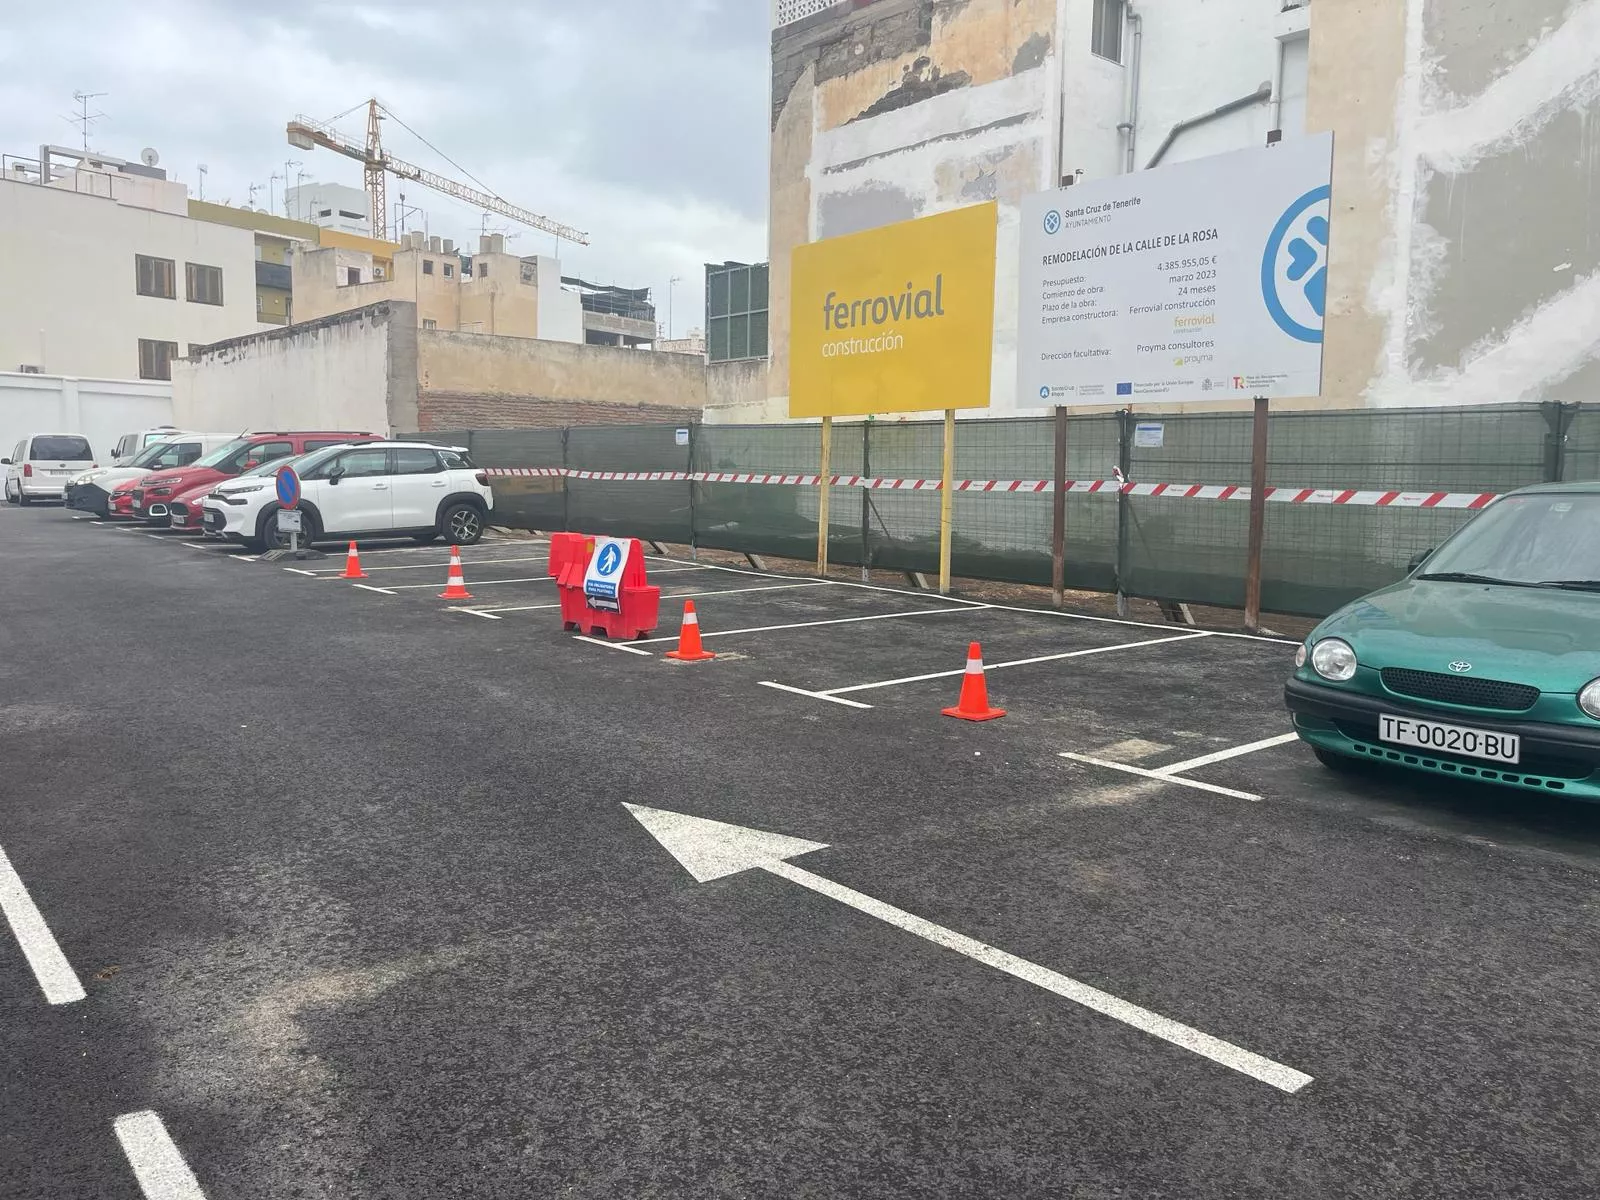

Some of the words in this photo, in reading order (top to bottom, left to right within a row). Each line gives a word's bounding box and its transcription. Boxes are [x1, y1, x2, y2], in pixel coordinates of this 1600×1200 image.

[1065, 209, 1085, 219] Santa
[1085, 205, 1101, 215] Cruz
[1102, 203, 1111, 212] de
[1112, 197, 1141, 210] Tenerife
[1065, 214, 1112, 229] AYUNTAMIENTO
[1042, 245, 1107, 266] REMODELACIÓN
[1109, 244, 1121, 256] DE
[1123, 242, 1134, 253] LA
[1135, 236, 1162, 251] CALLE
[1164, 234, 1176, 247] DE
[1178, 232, 1190, 245] LA
[1192, 228, 1218, 243] ROSA
[1157, 256, 1210, 271] 4.385.955,05
[1211, 255, 1217, 265] €
[1169, 273, 1194, 283] marzo
[1196, 269, 1217, 280] 2023
[1042, 289, 1075, 300] Comienzo
[1076, 287, 1086, 295] de
[1178, 286, 1188, 296] 24
[1190, 284, 1216, 295] meses
[823, 272, 945, 331] ferrovial
[1042, 303, 1060, 312] Plazo
[1061, 302, 1070, 310] de
[1071, 301, 1077, 309] la
[1079, 299, 1097, 308] obra:
[1129, 302, 1163, 314] Ferrovial
[1164, 297, 1216, 311] construcción
[1042, 315, 1071, 325] Empresa
[1071, 309, 1119, 321] constructora:
[1175, 313, 1216, 328] ferrovial
[821, 329, 904, 358] construcción
[1136, 343, 1166, 354] Proyma
[1168, 340, 1215, 350] consultores
[1041, 352, 1072, 361] Dirección
[1073, 348, 1112, 358] facultativa:
[1184, 354, 1213, 364] proyma
